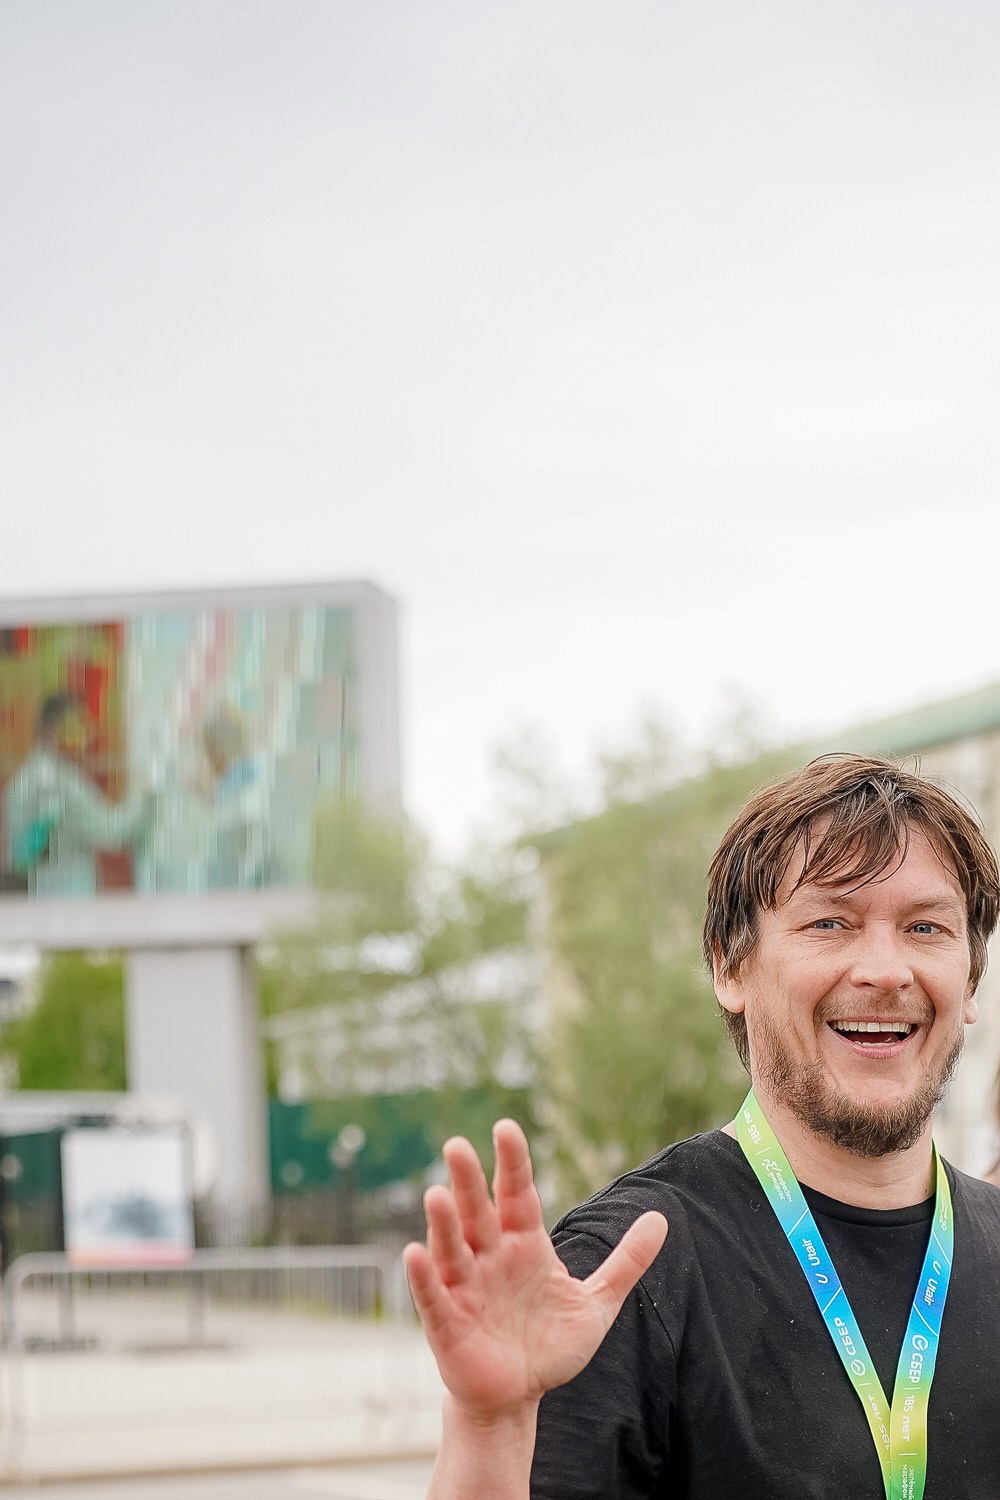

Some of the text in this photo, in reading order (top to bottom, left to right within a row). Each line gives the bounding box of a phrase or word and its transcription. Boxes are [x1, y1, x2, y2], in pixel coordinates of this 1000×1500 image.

[747, 1124, 763, 1145] 185
[776, 1172, 793, 1203] марафон
[802, 1238, 821, 1267] Utair
[924, 1277, 939, 1306] Utair
[834, 1316, 857, 1356] СБЕР
[908, 1352, 924, 1384] СБЕР
[902, 1394, 915, 1442] 185 лет
[879, 1424, 890, 1450] 185
[901, 1464, 909, 1499] марафон
